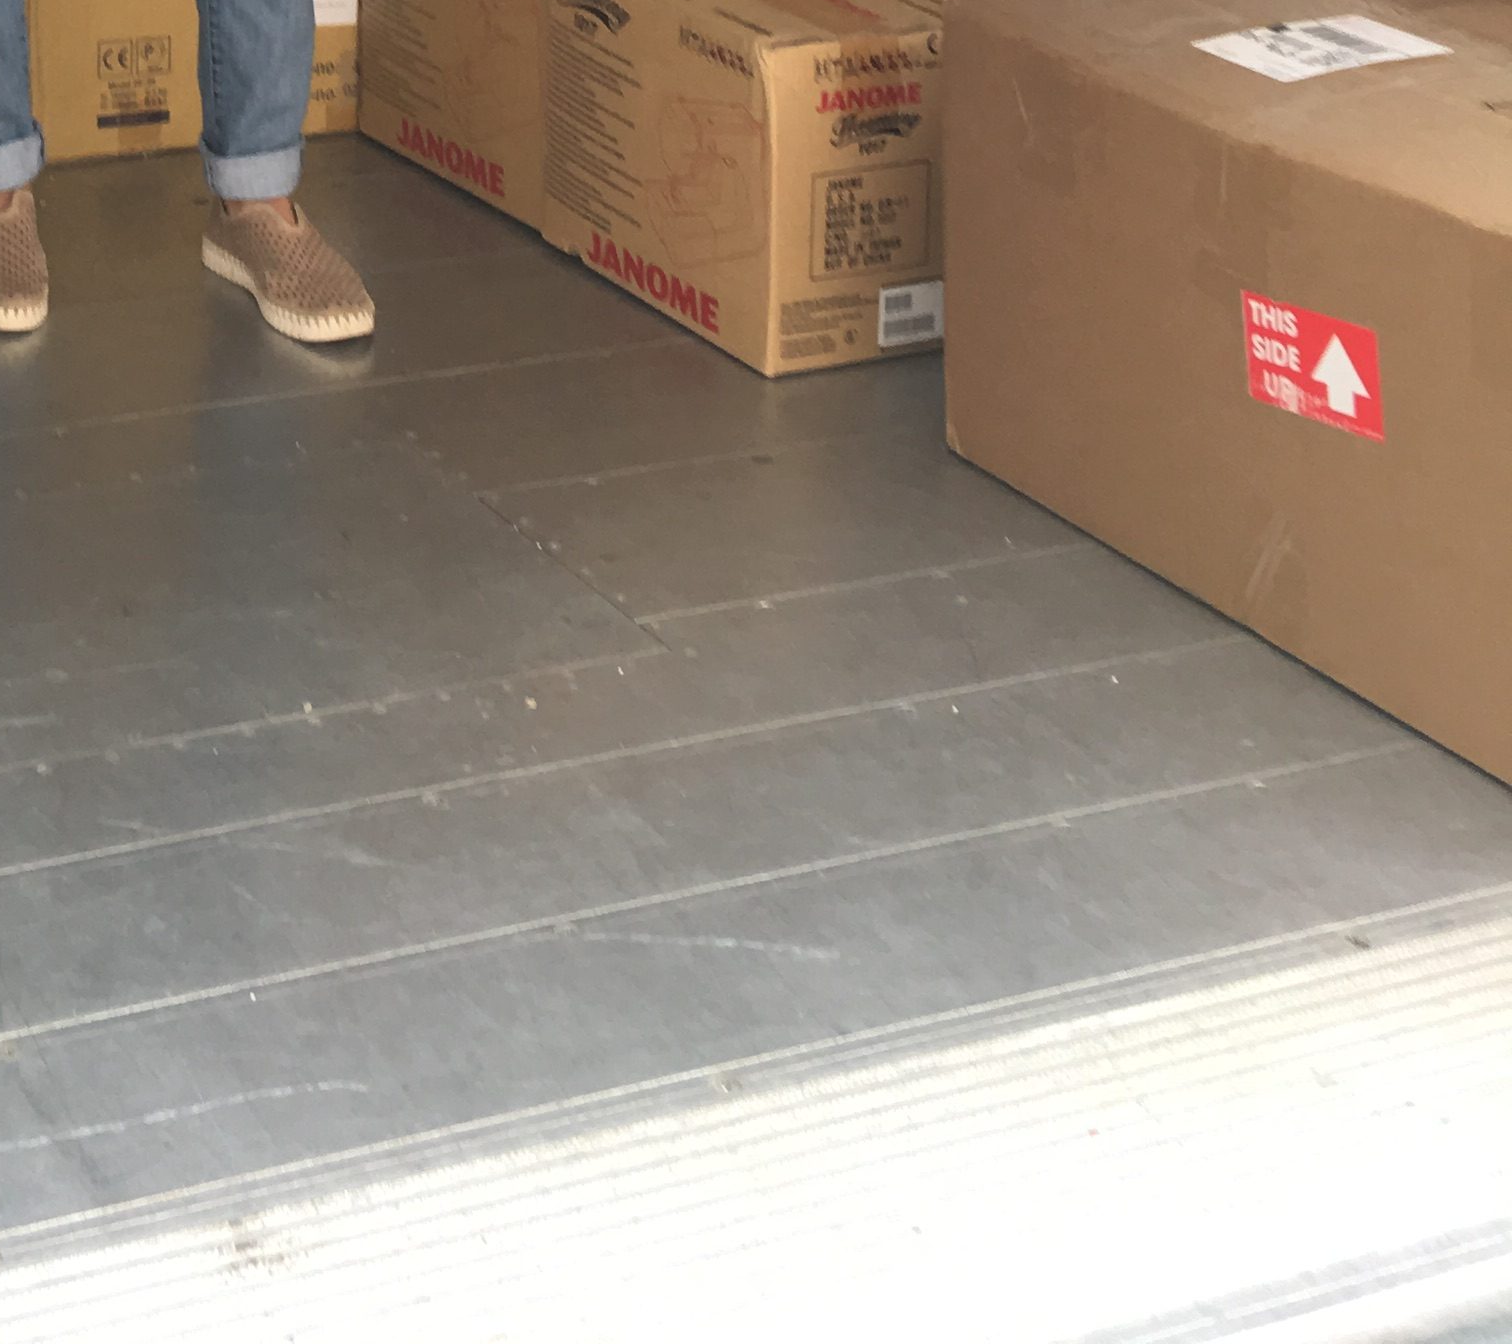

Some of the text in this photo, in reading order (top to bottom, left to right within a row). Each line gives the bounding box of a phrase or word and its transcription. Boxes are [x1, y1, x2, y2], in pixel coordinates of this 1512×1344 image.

[815, 81, 923, 114] JANOME
[395, 116, 506, 198] JANOME
[587, 230, 721, 336] JANOME
[1247, 297, 1299, 339] THIS
[1251, 332, 1302, 374] SIDE
[1262, 368, 1299, 409] UP
